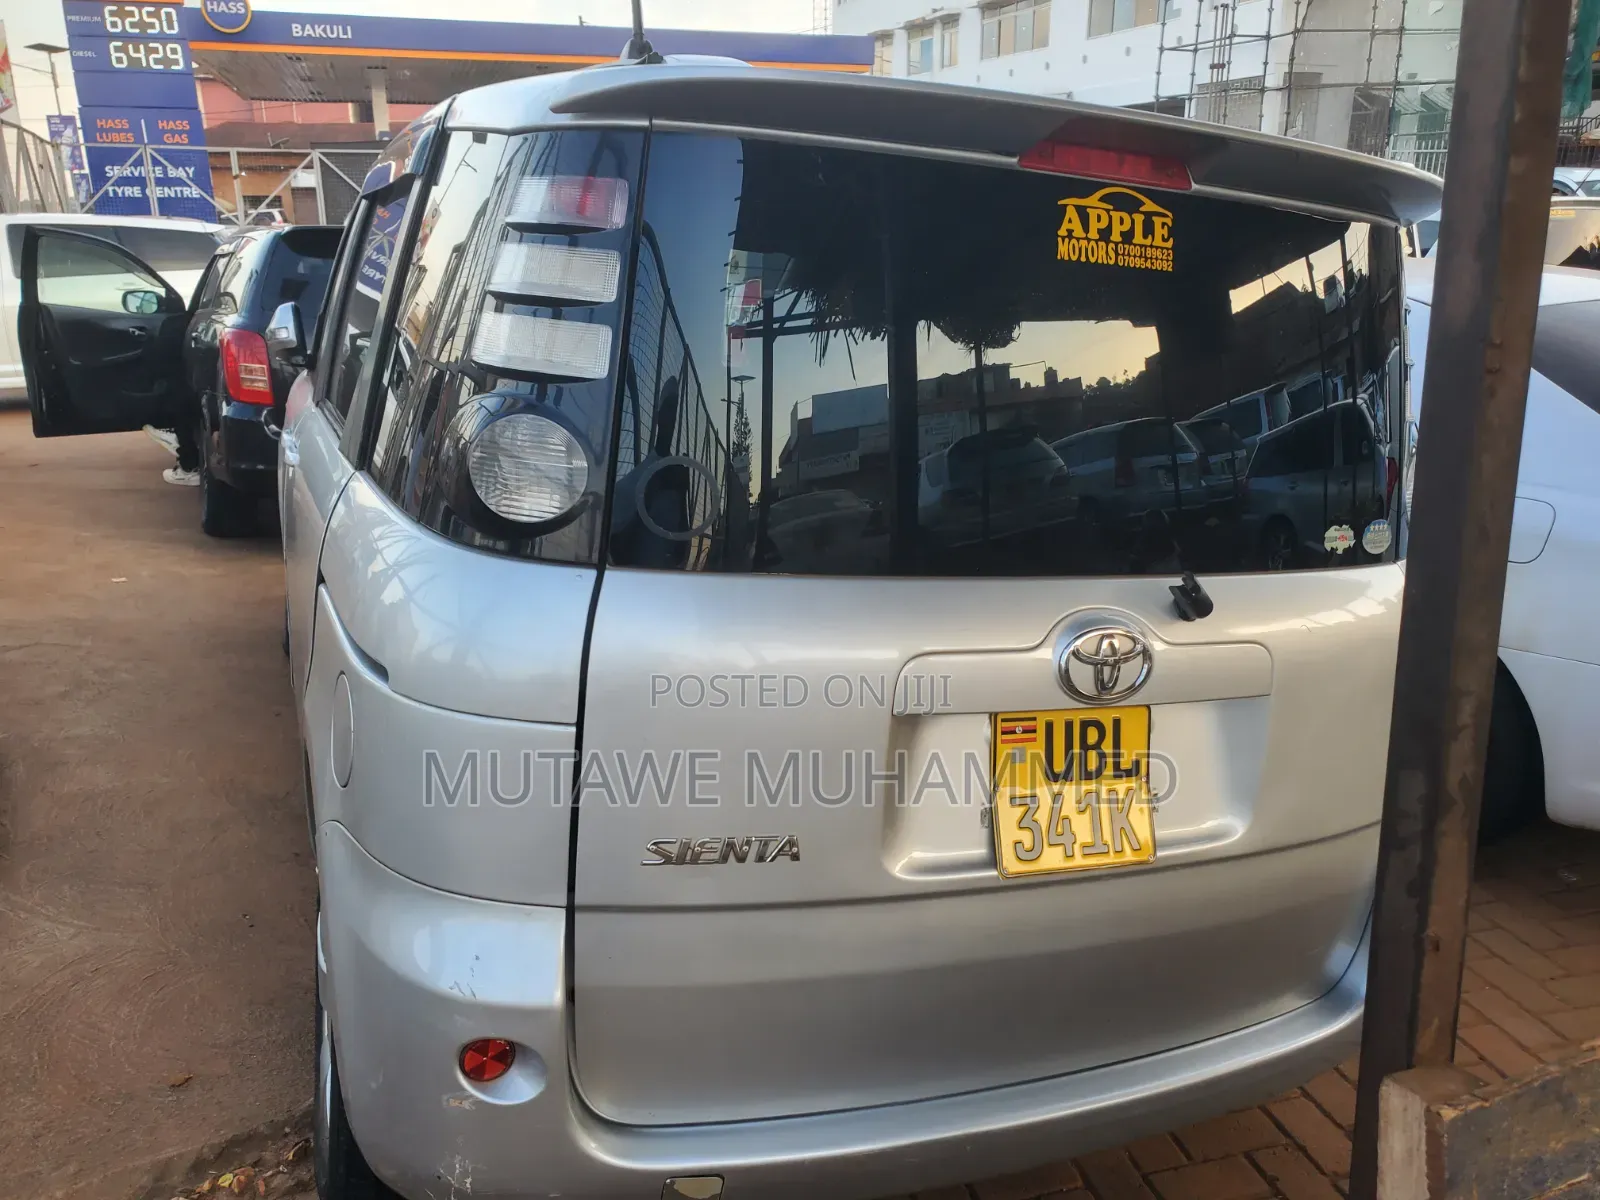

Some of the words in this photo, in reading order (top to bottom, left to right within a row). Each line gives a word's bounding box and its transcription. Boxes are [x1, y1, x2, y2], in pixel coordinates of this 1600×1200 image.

[207, 1, 246, 14] HASS
[104, 5, 179, 34] 6250
[291, 24, 352, 39] BAKULI
[72, 50, 98, 58] DIESEL
[109, 41, 184, 70] 6429
[96, 119, 129, 129] HASS
[158, 120, 190, 130] HASS
[96, 132, 134, 143] LUBES
[163, 133, 189, 143] GAS
[105, 166, 163, 177] SERVIE
[168, 167, 195, 178] BAY
[106, 186, 143, 198] TYRE
[1057, 204, 1174, 249] APPLE
[1057, 237, 1116, 265] MOTORS
[1117, 243, 1173, 261] 0700189623
[1117, 255, 1173, 272] 0709543092
[1044, 717, 1141, 783] UBL
[1010, 789, 1142, 863] 341K
[640, 834, 801, 866] SIENTA
